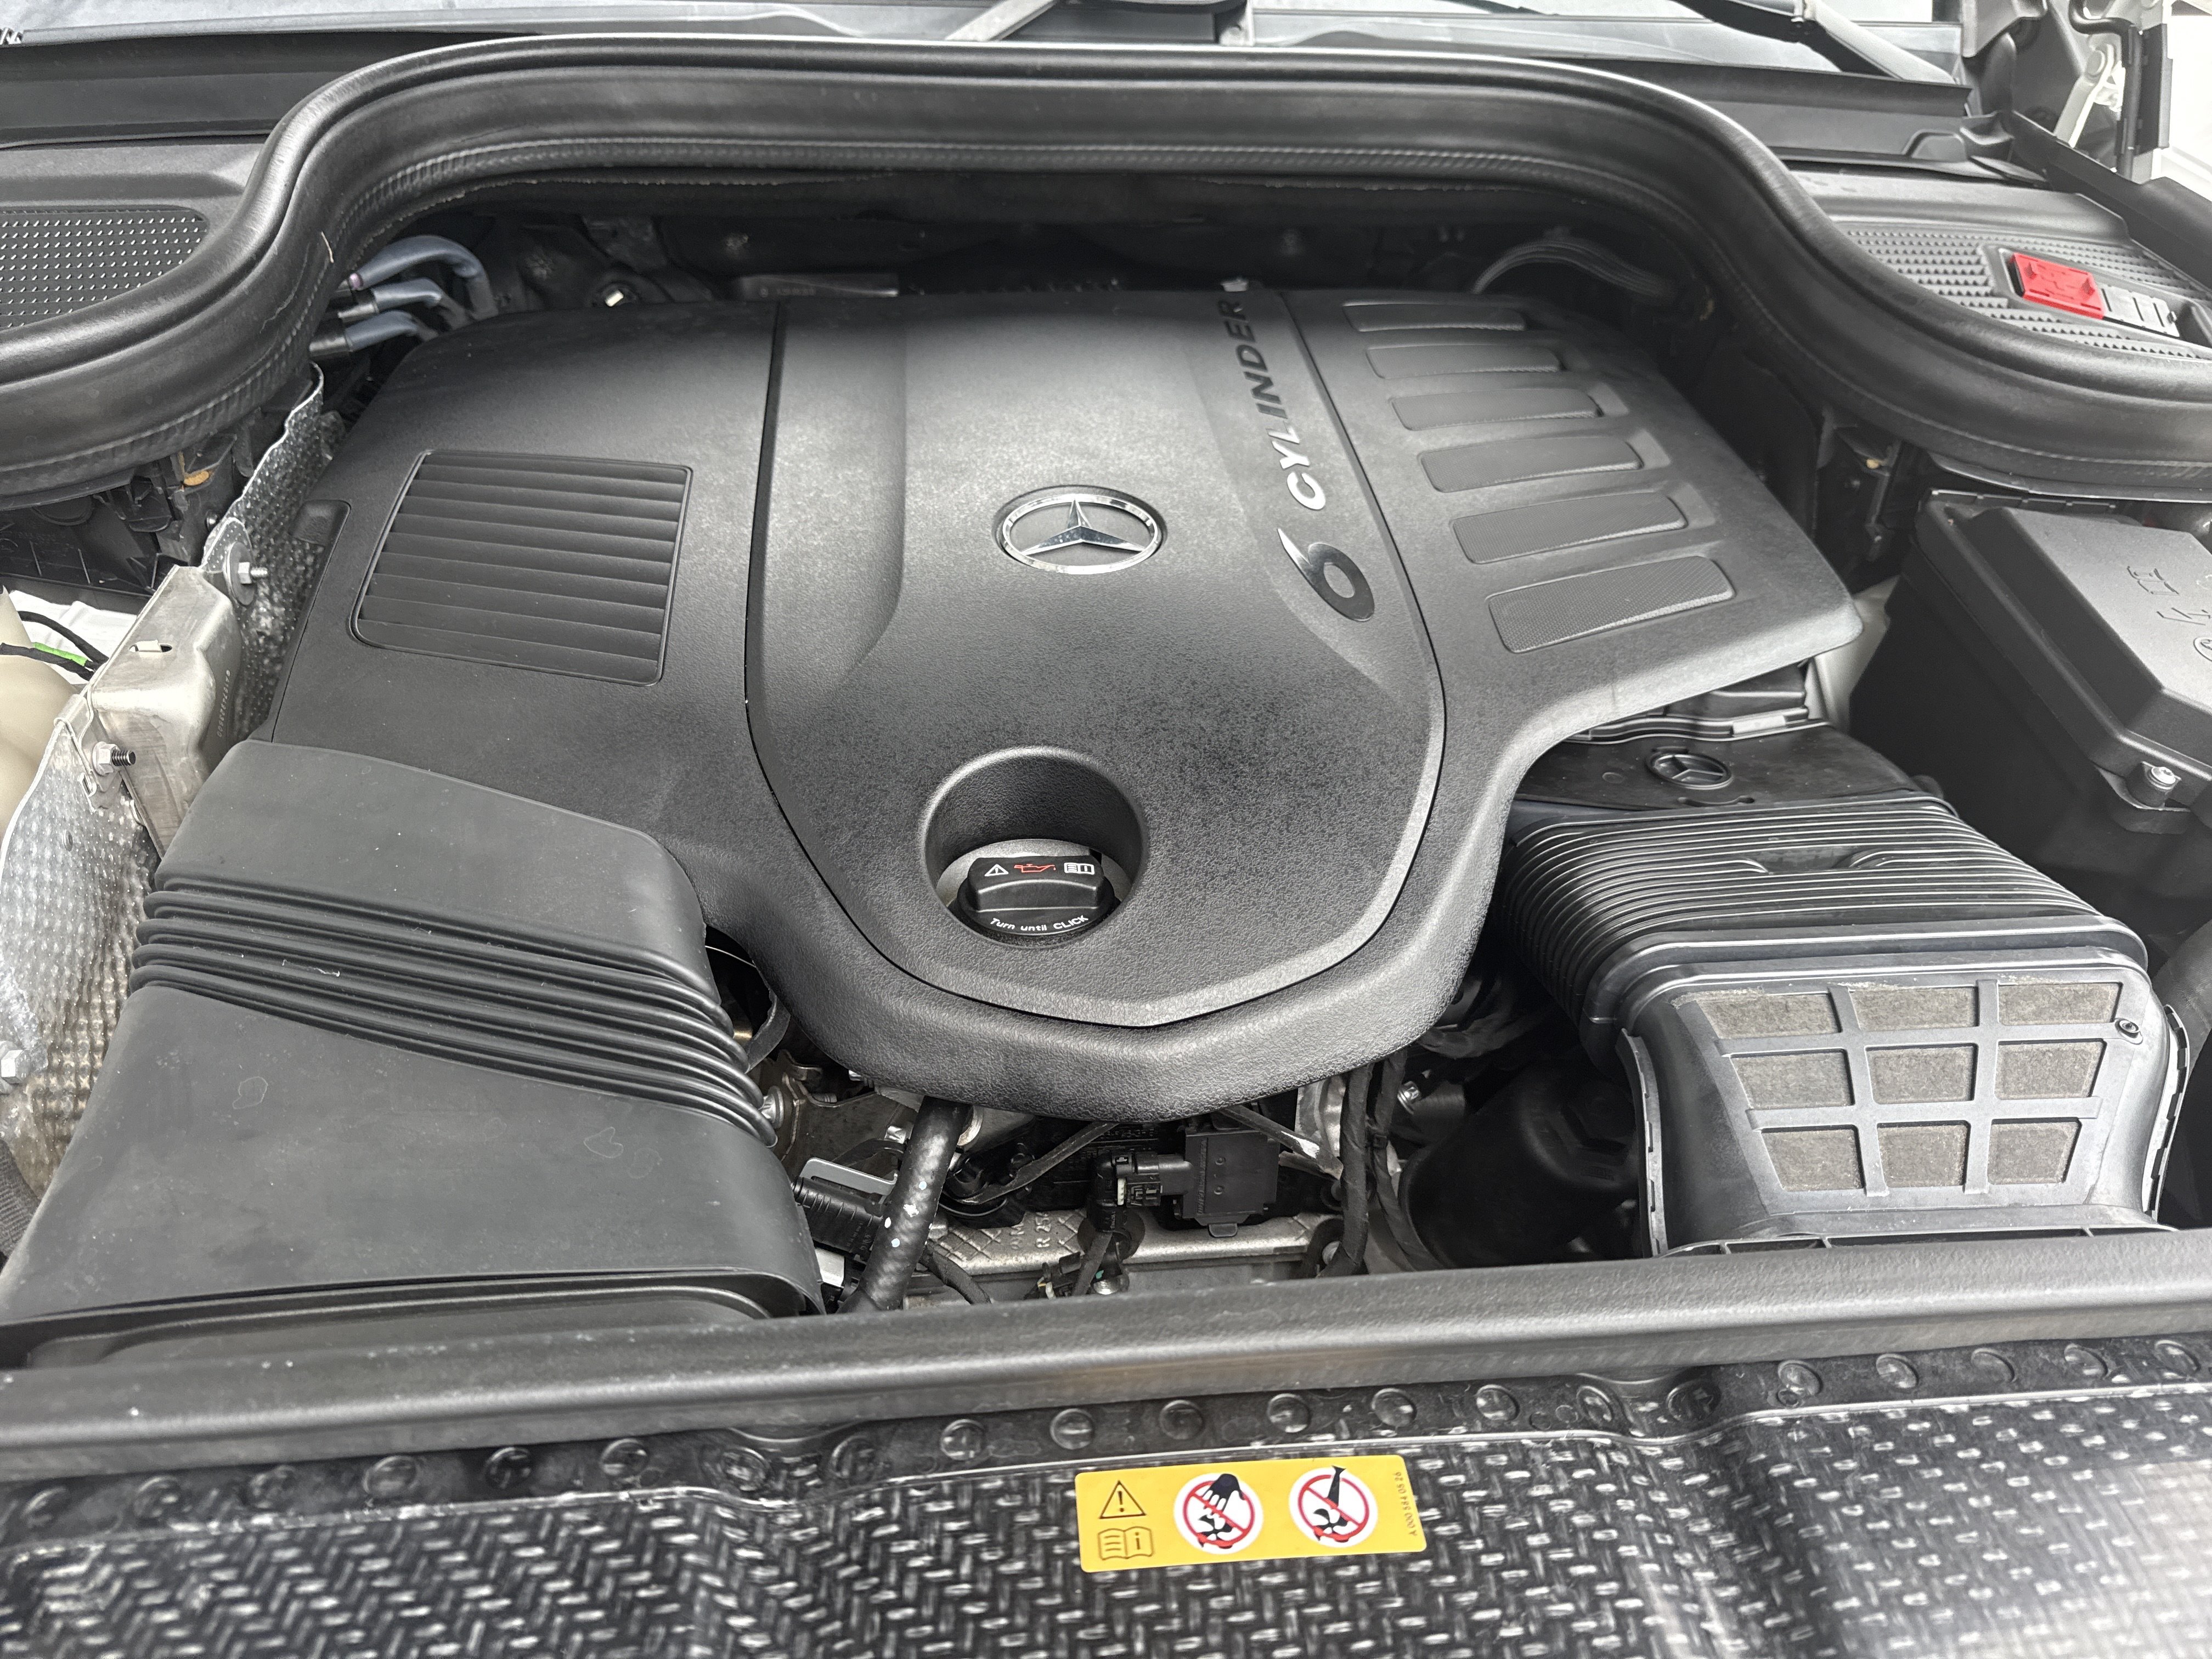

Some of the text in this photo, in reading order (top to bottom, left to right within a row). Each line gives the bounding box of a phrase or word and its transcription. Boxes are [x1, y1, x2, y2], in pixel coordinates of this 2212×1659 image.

[1218, 299, 1375, 623] 6 CYLINDER
[990, 918, 1015, 930] Turn
[1053, 915, 1088, 929] CLICK
[1404, 1513, 1415, 1528] 000
